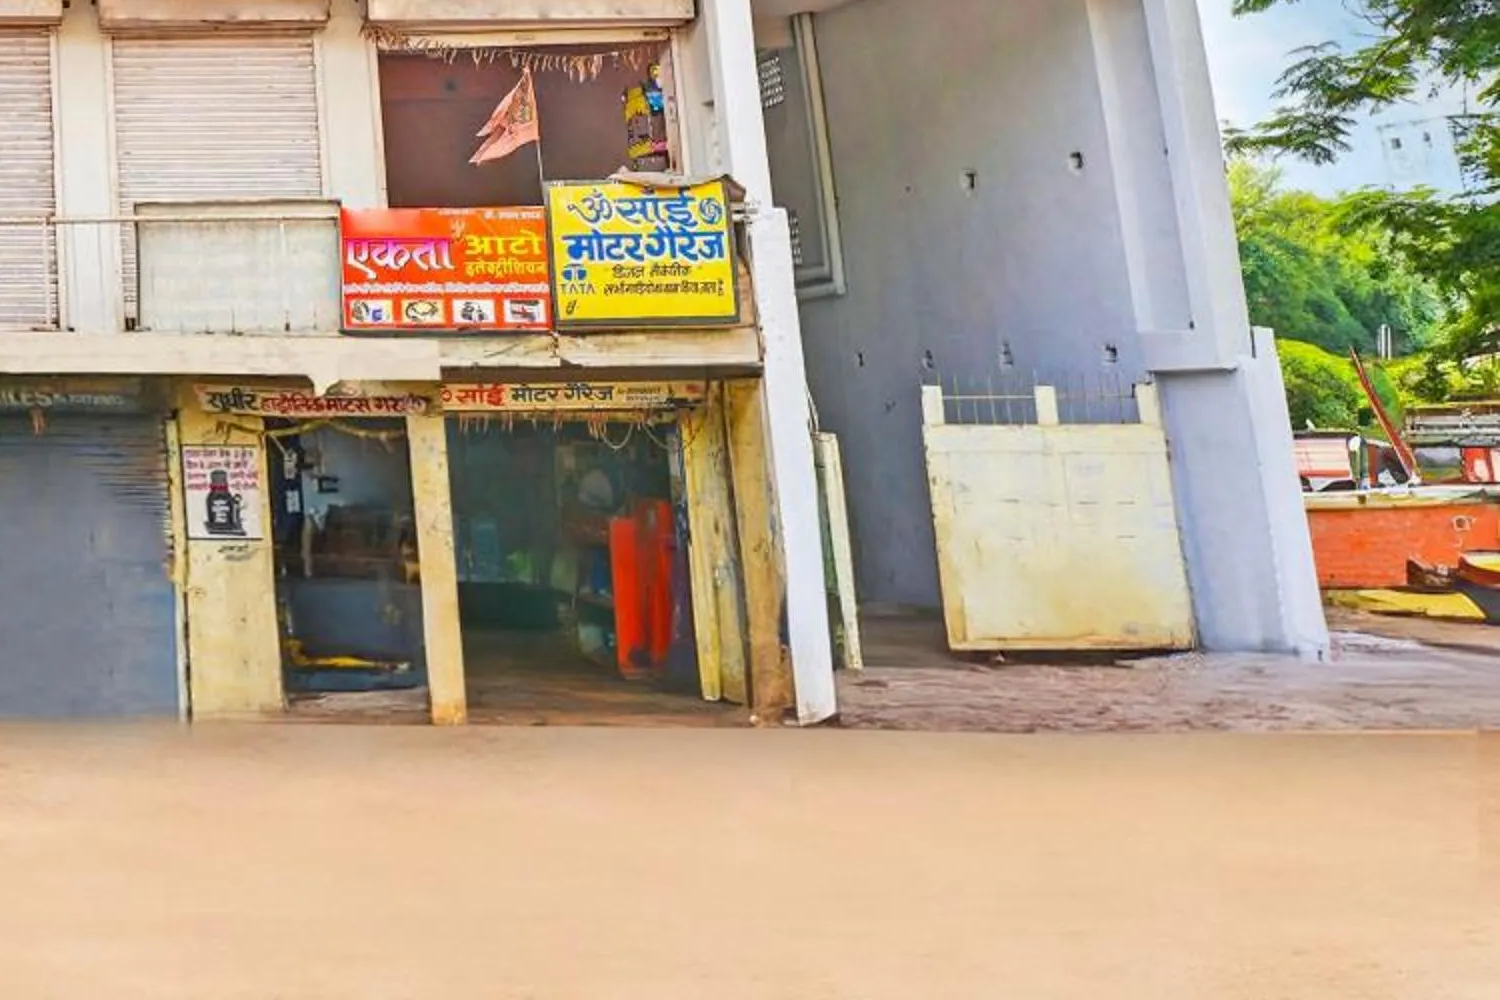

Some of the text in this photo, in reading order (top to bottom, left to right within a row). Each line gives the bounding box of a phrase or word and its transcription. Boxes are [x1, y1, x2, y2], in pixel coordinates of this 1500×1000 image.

[346, 238, 454, 279] एकता
[562, 229, 645, 261] मोटर
[561, 283, 596, 295] TATA
